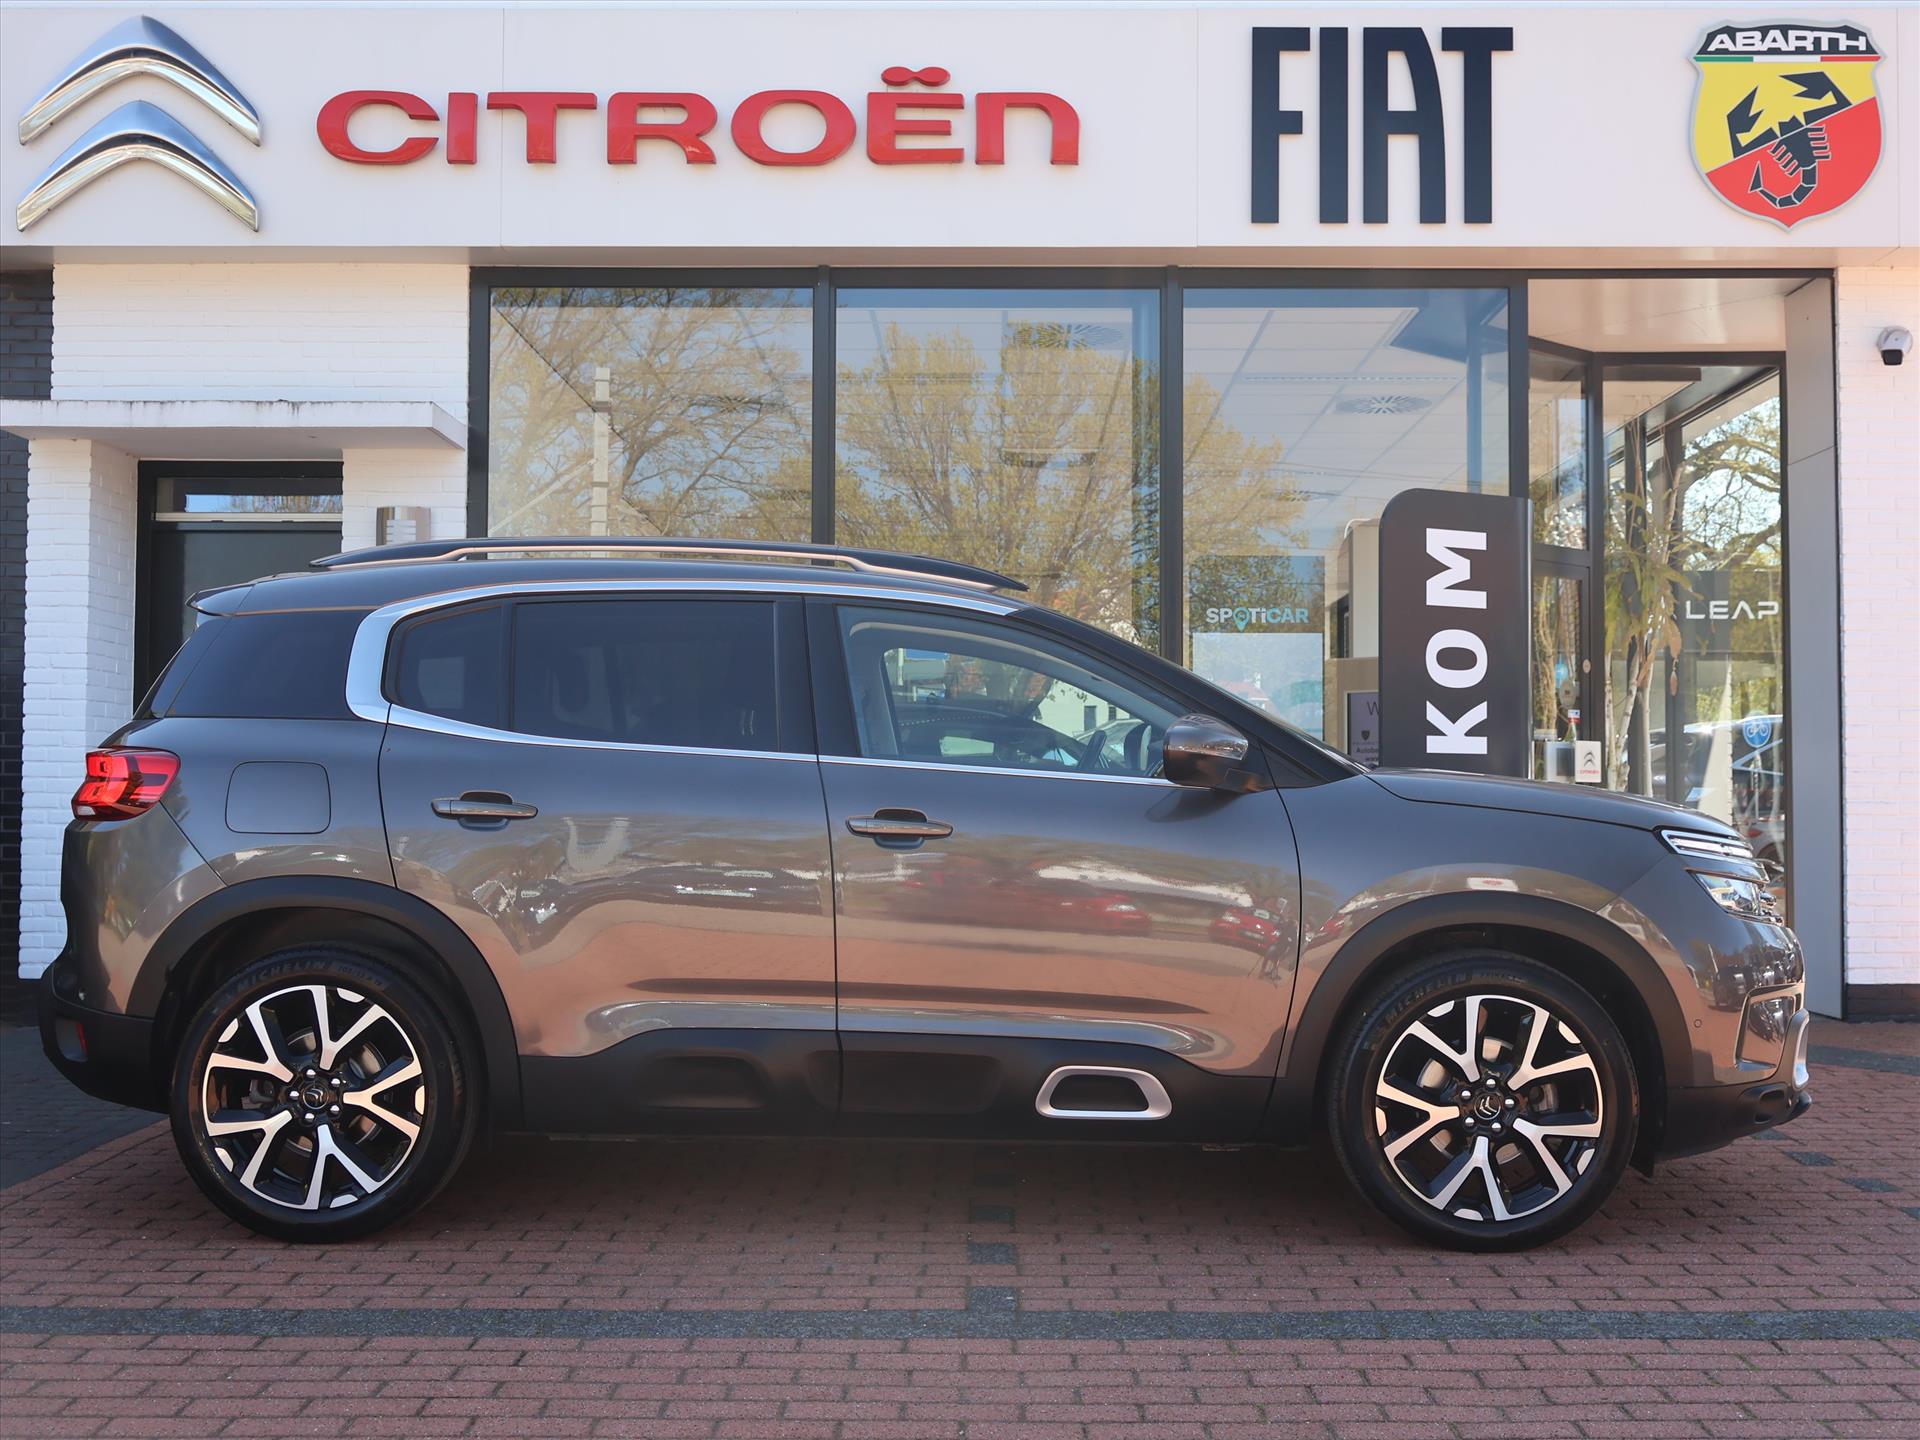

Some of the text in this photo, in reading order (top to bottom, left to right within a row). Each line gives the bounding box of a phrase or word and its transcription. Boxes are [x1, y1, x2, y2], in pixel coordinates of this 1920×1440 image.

[1707, 29, 1867, 52] ABARTH
[316, 66, 1080, 166] CITROËN
[1251, 27, 1513, 224] FIAT
[1425, 527, 1488, 755] KOM
[1685, 600, 1779, 620] LEAP
